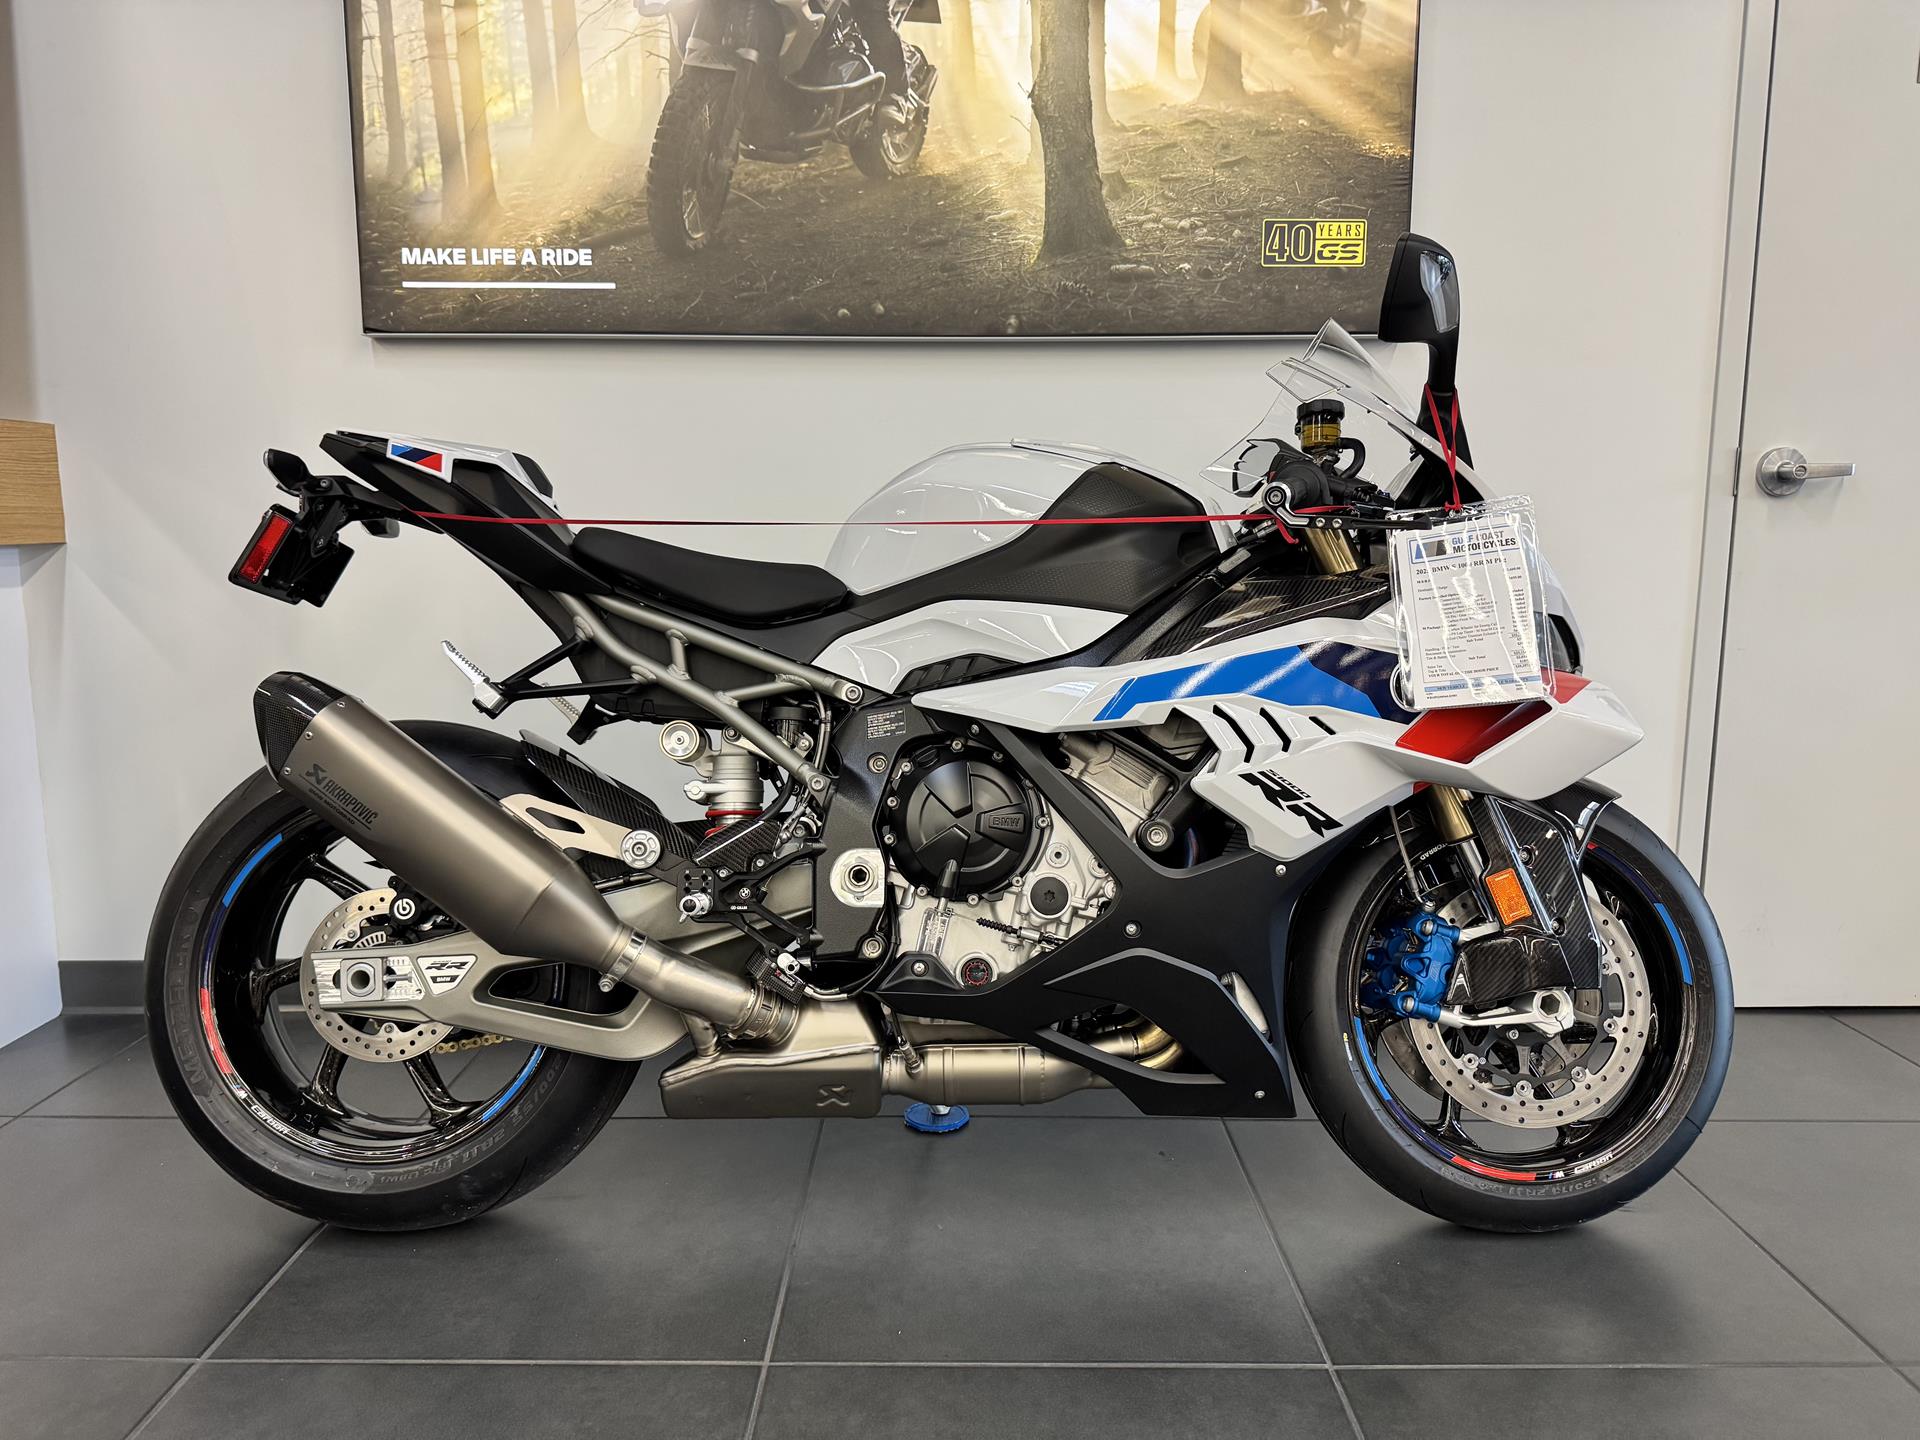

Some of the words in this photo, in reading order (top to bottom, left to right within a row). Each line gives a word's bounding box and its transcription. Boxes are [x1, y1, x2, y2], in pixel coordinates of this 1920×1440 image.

[1266, 224, 1314, 262] 40
[1319, 224, 1361, 237] YEARS
[1317, 243, 1361, 260] GS
[401, 247, 466, 265] MAKE
[471, 248, 516, 265] LIFE
[520, 248, 537, 265] A
[541, 248, 593, 266] RIDE
[1452, 534, 1474, 545] GUF
[1266, 768, 1312, 798] S1000
[1237, 770, 1344, 838] RR
[992, 816, 1021, 827] BMW
[251, 1104, 290, 1134] Carbon
